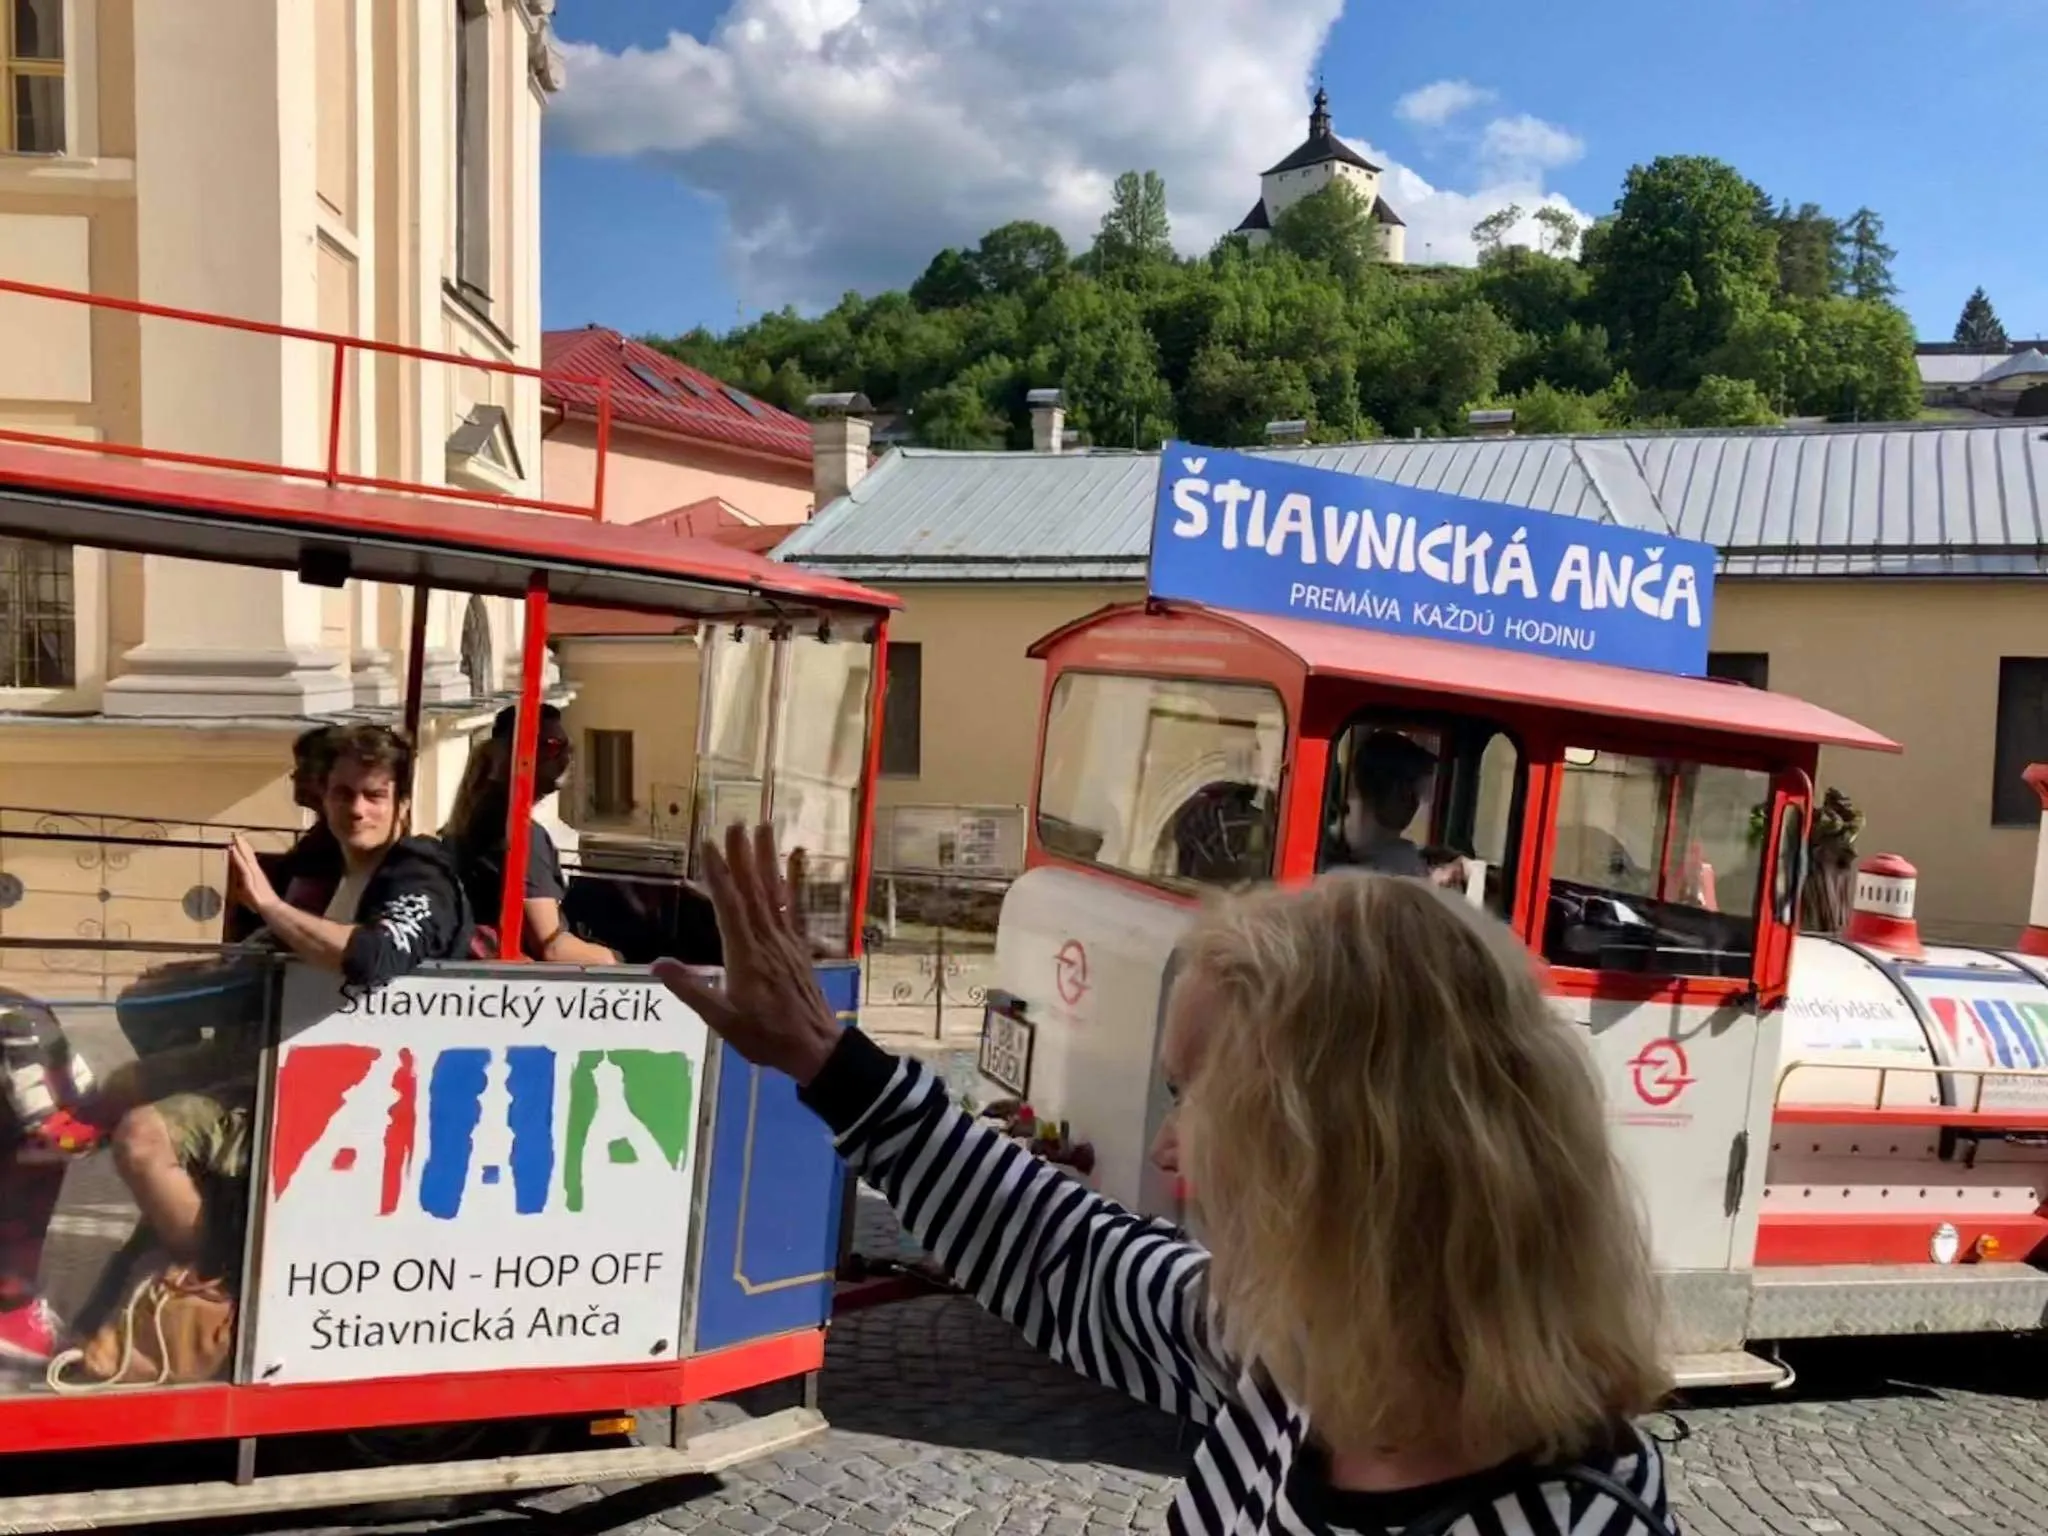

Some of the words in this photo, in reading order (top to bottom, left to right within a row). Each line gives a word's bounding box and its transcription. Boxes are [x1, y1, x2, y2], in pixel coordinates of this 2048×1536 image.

[1173, 457, 1539, 598] ŠTIAVNICKÁ
[1551, 545, 1702, 628] ANČA
[1289, 582, 1402, 623] PREMÁVA
[1412, 602, 1495, 636] KAŽDÚ
[1504, 616, 1596, 651] HODINU
[556, 986, 664, 1022] vláčik
[287, 1260, 381, 1297] HOP
[392, 1257, 456, 1293] ON
[494, 1255, 580, 1290] HOP
[590, 1251, 665, 1286] OFF
[310, 1308, 516, 1351] Štiavnická
[528, 1304, 621, 1340] Anča
